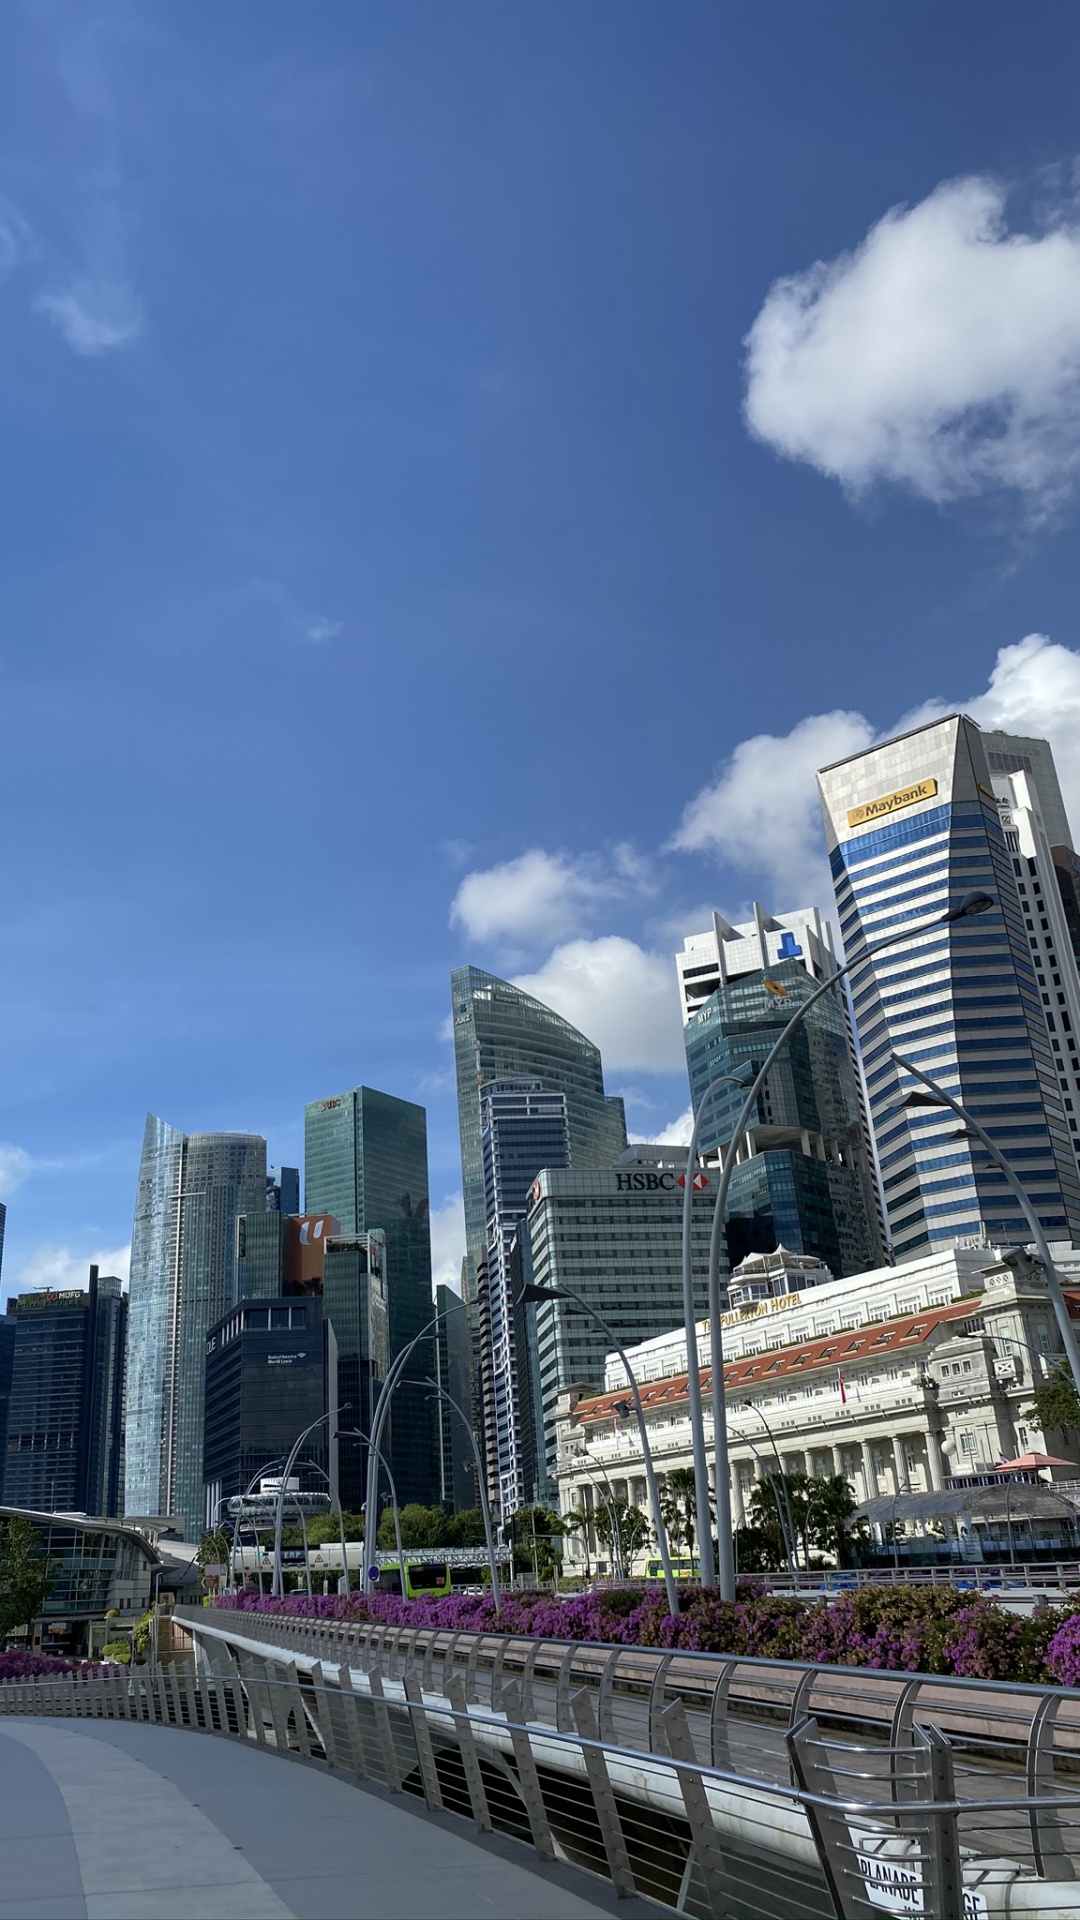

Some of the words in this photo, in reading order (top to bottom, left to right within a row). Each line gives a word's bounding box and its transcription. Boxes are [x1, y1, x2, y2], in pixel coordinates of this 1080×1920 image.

[866, 786, 927, 816] Maybank
[764, 998, 792, 1013] MYP
[698, 1008, 712, 1024] MYP
[615, 1173, 675, 1191] HSBC
[58, 1291, 81, 1299] MUFG
[770, 1292, 802, 1313] HOTEL
[860, 1858, 920, 1905] PLANADE
